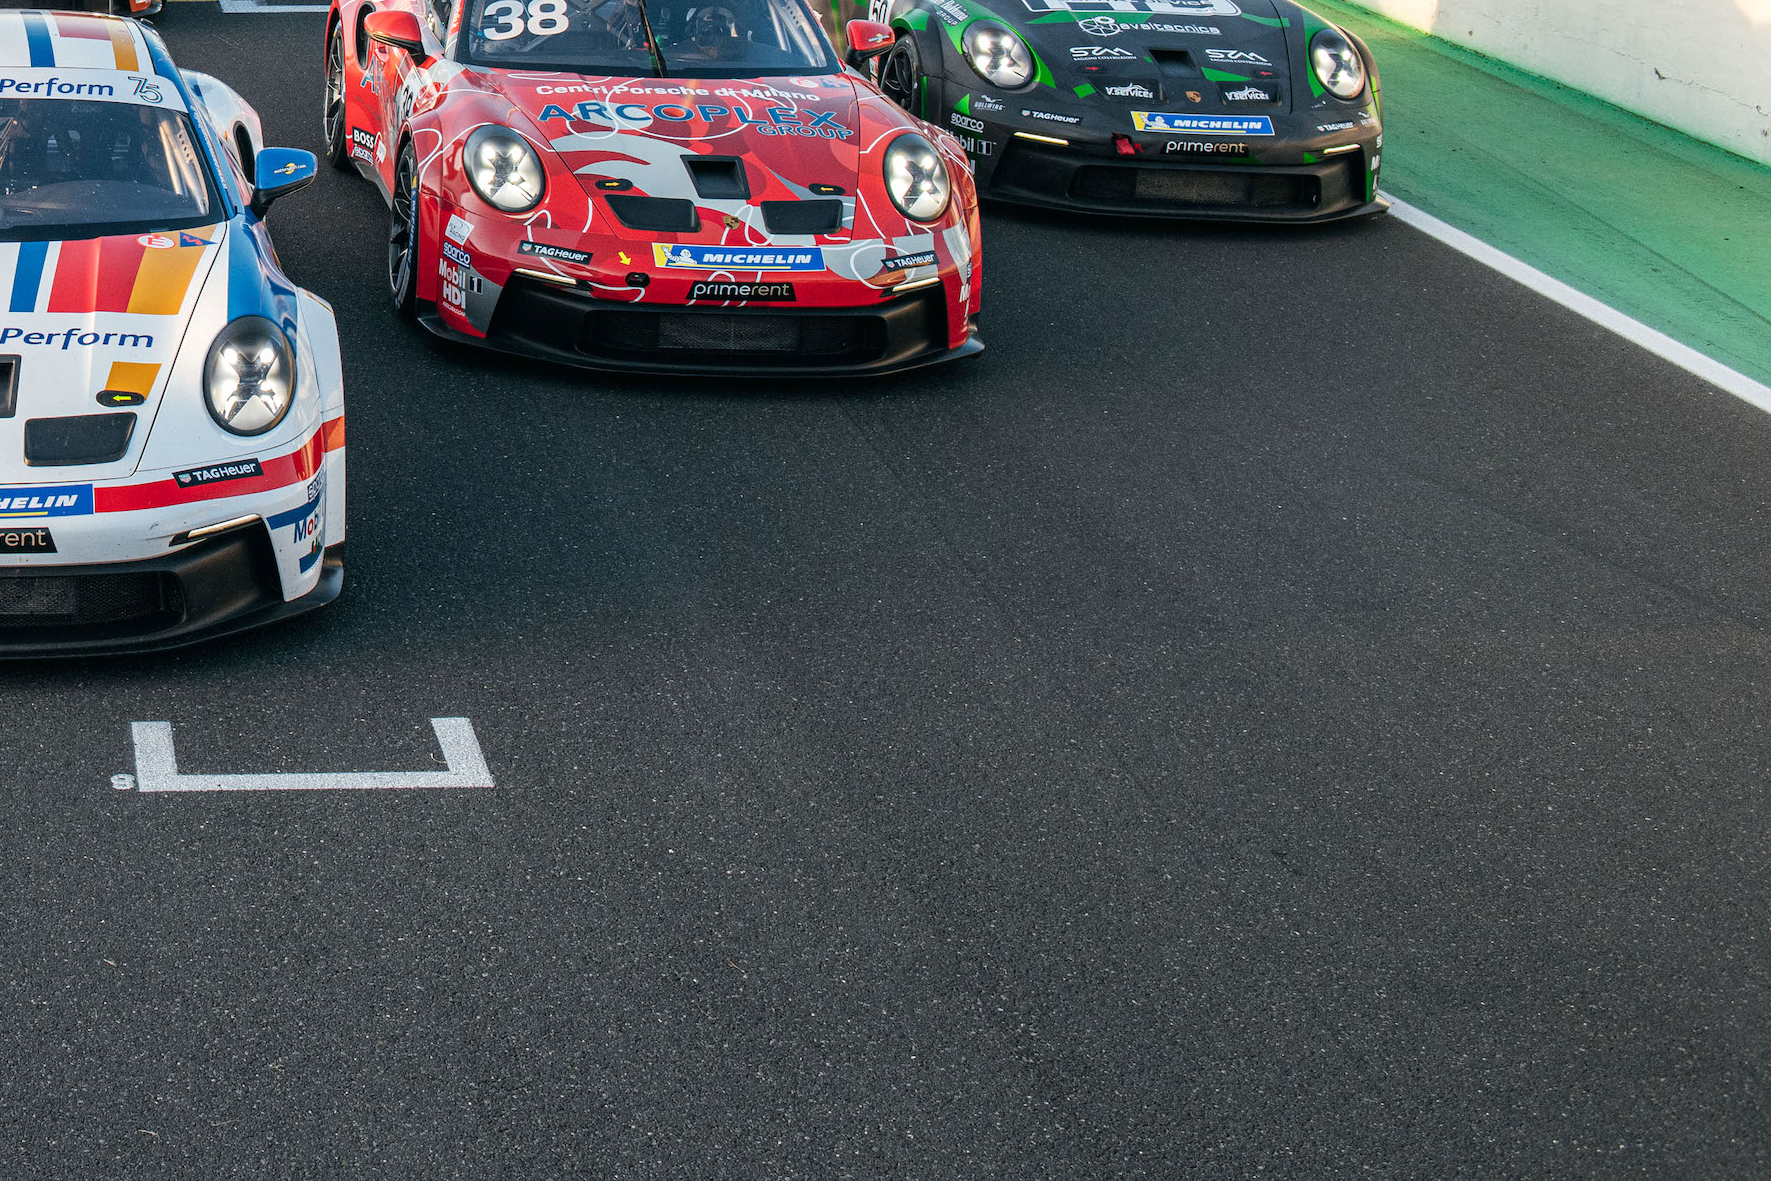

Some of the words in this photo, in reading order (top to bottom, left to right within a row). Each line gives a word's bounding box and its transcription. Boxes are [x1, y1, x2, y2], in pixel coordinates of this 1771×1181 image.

[128, 76, 164, 103] 75
[536, 84, 608, 96] Centri
[614, 85, 710, 98] Porsche
[714, 88, 735, 98] di
[737, 89, 821, 102] Milano
[538, 101, 842, 129] ARCOPLEX
[951, 113, 984, 132] sparco
[756, 124, 854, 141] GROUP
[1173, 119, 1263, 130] MICHELIN
[353, 129, 374, 150] BOSS
[1166, 140, 1245, 154] primerent
[444, 242, 471, 265] sparco
[533, 244, 589, 262] TAGHeuer
[702, 253, 812, 264] MICHELIN
[894, 253, 936, 268] TAGHeuer
[438, 258, 466, 290] Mobil
[442, 280, 466, 310] HDI
[694, 282, 790, 298] primerent
[192, 462, 257, 482] TAGHeuer
